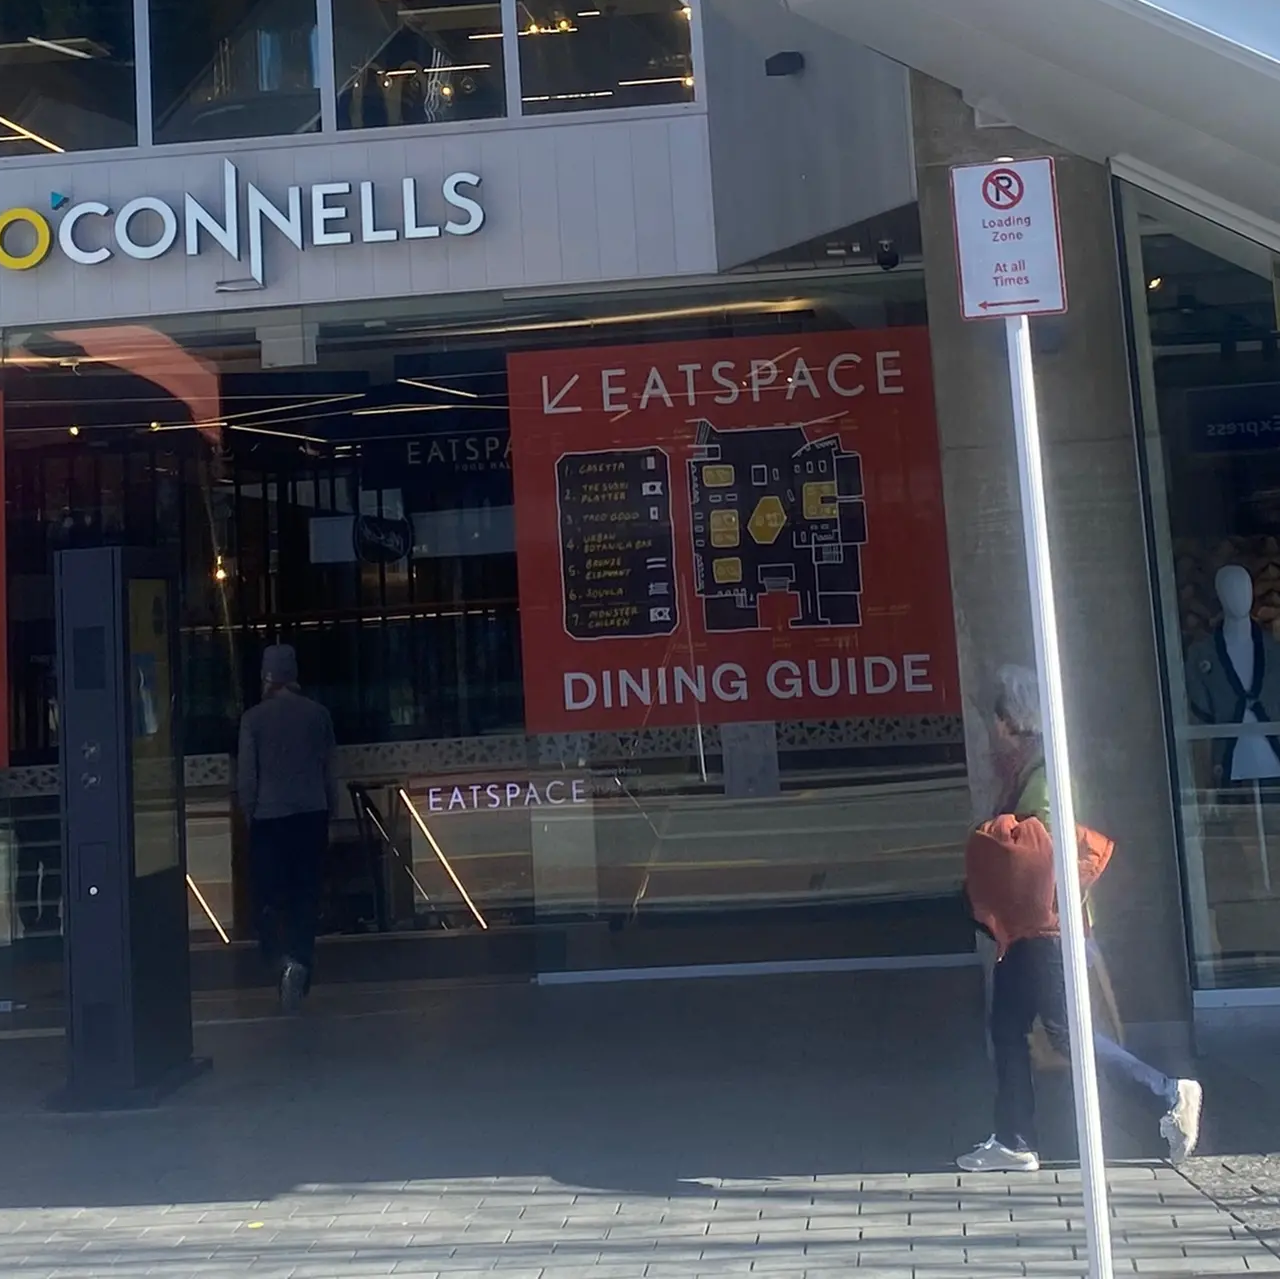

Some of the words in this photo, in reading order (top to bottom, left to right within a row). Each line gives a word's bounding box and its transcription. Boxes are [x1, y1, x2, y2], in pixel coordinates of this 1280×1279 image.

[982, 215, 1031, 229] Loading
[992, 230, 1023, 242] Zone
[995, 262, 1008, 273] At
[1011, 260, 1026, 271] all
[992, 275, 1030, 287] Times
[601, 350, 904, 413] EATSPACE
[563, 662, 748, 710] DINING
[766, 654, 933, 700] GUIDE
[428, 779, 587, 812] EATSPACE
